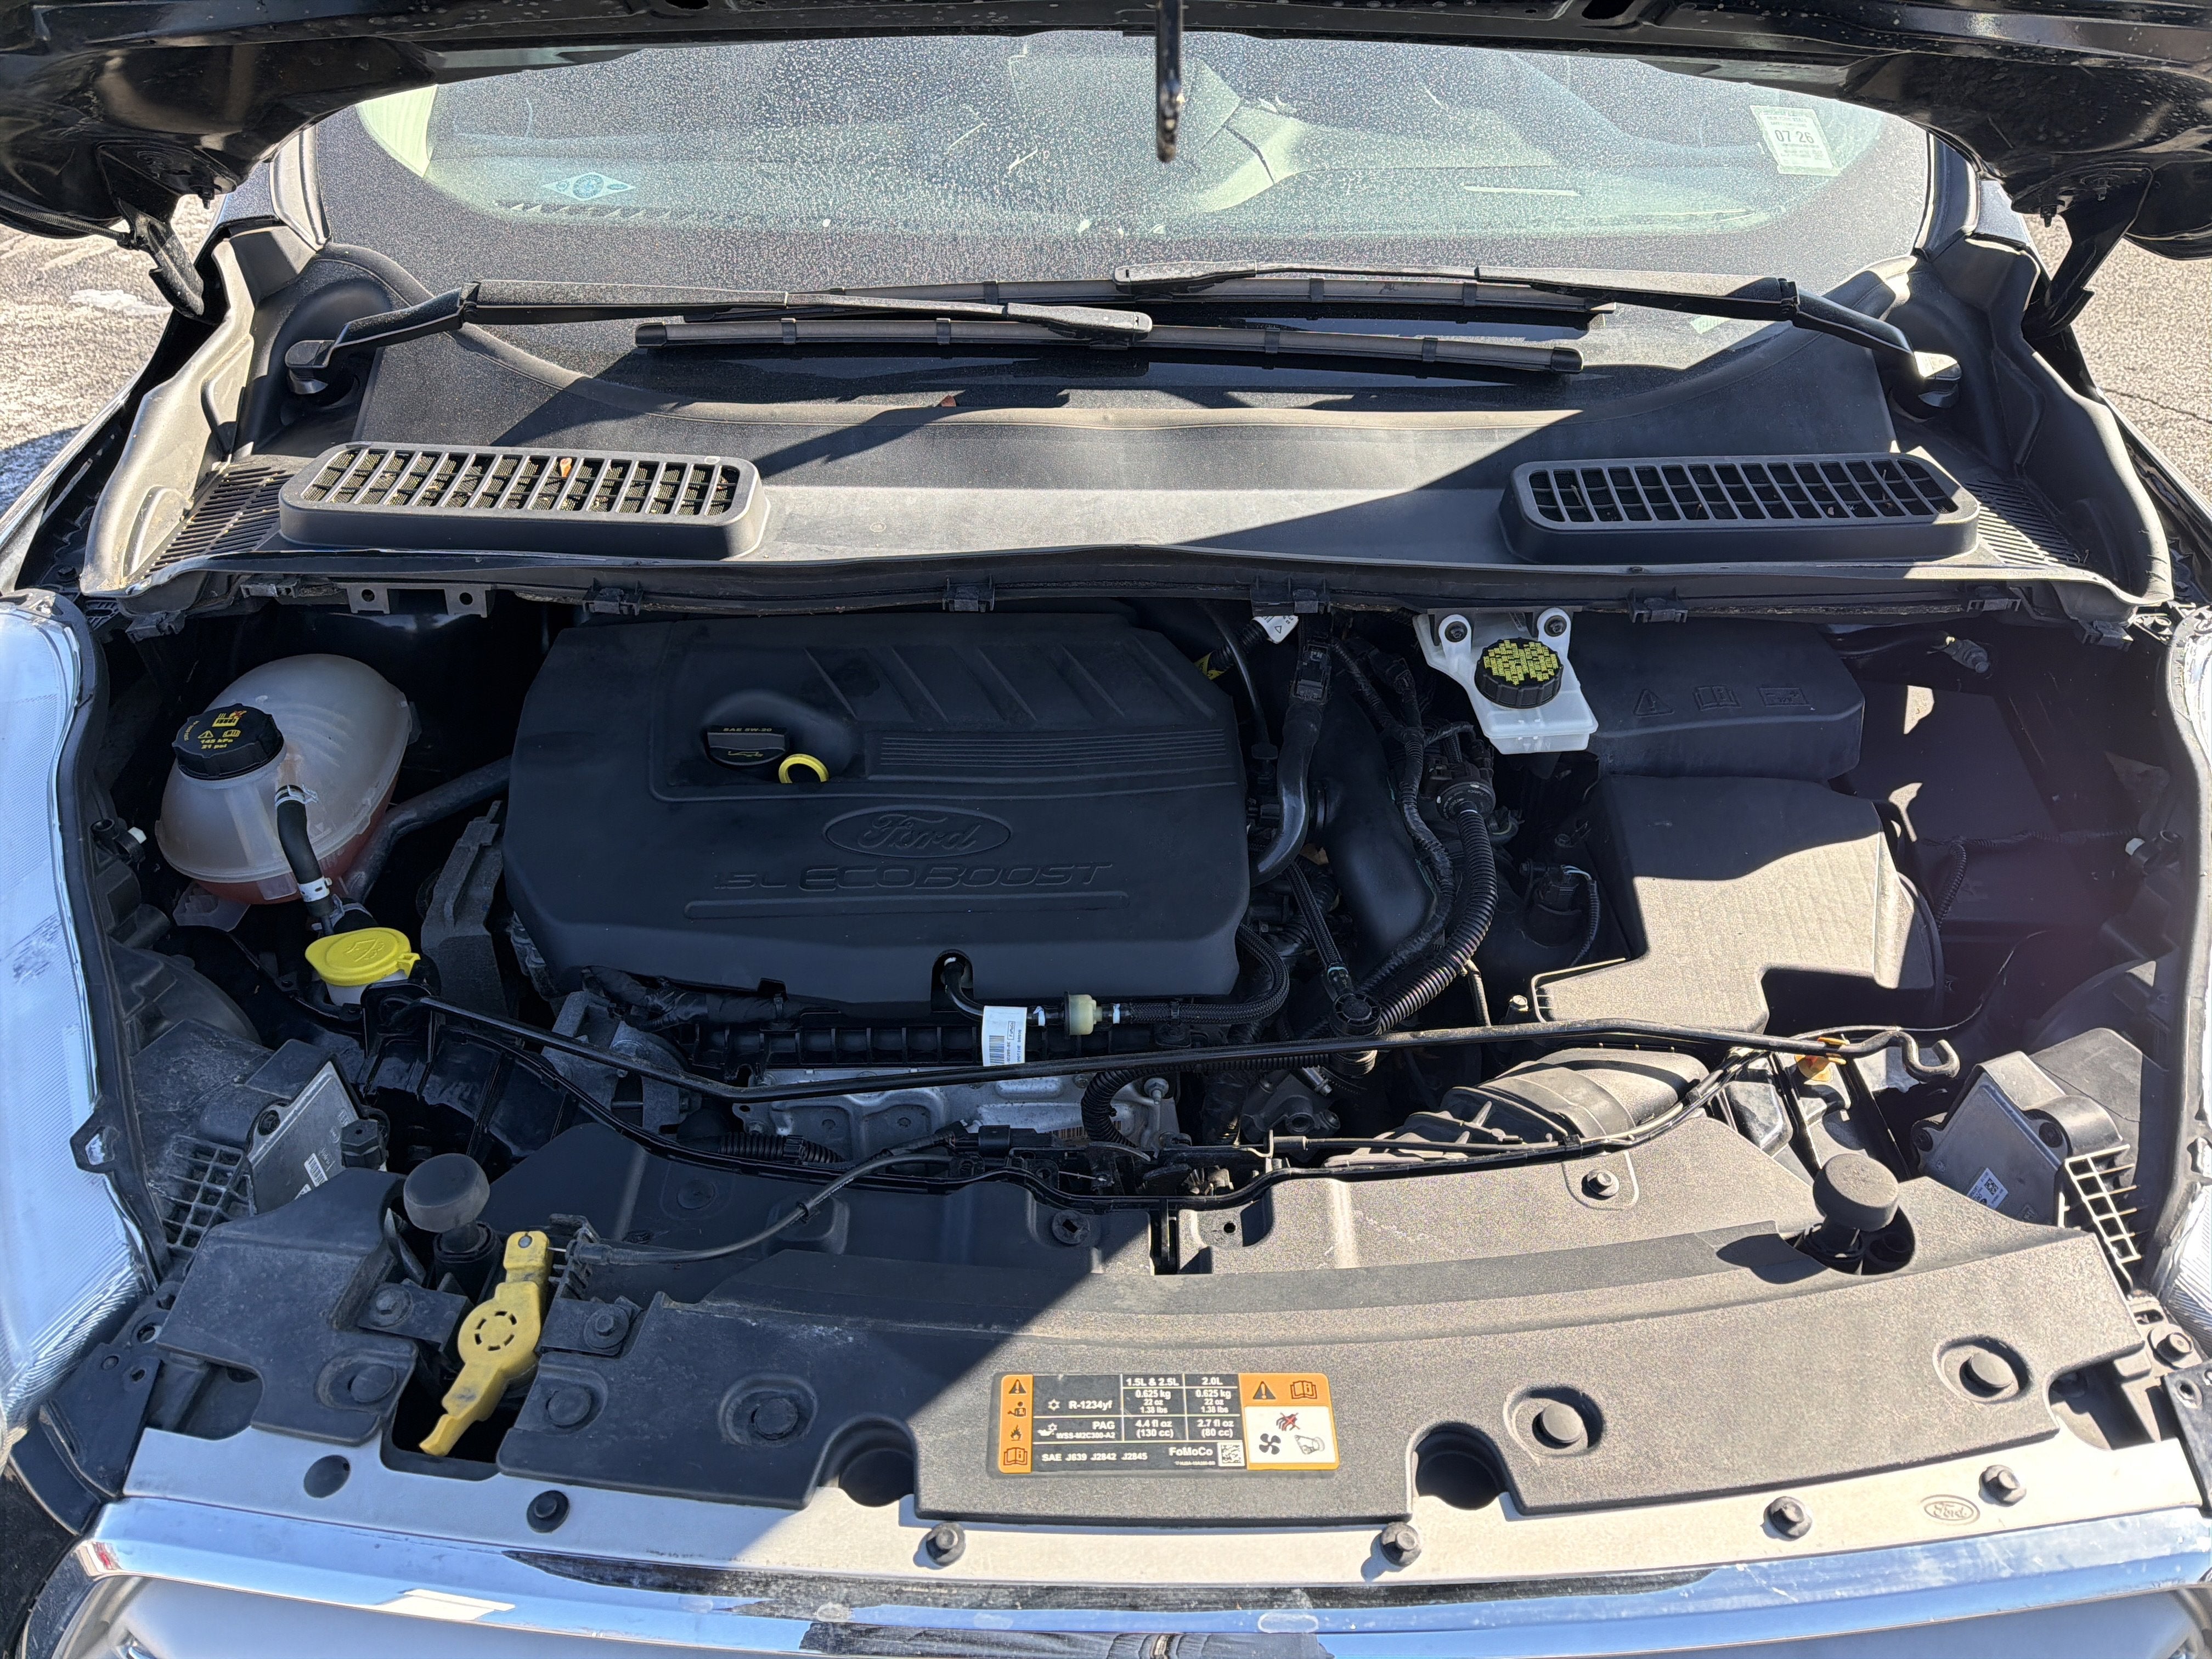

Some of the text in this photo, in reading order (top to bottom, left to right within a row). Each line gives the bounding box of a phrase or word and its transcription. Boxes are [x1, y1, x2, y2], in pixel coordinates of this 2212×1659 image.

[1775, 129, 1815, 144] 07 26
[1525, 648, 1533, 659] SEALED
[1536, 672, 1544, 681] FROM
[857, 813, 982, 850] Ford
[1126, 1378, 1180, 1386] 1.5L & 2.5L
[1201, 1377, 1223, 1385] 2.0L
[1135, 1390, 1171, 1400] 0.625 kg
[1195, 1390, 1232, 1400] 0.625 kg
[1068, 1400, 1113, 1409] R-1234yf
[1092, 1421, 1115, 1430] PAG
[1153, 1419, 1160, 1427] fl
[1213, 1419, 1220, 1427] fl
[1136, 1429, 1173, 1438] (130 cc)
[1201, 1429, 1233, 1438] (80 cc)
[1169, 1447, 1213, 1457] FoMoCo
[1041, 1453, 1148, 1462] SAE J639 J2842 J2845
[1933, 1502, 1967, 1518] Ford
